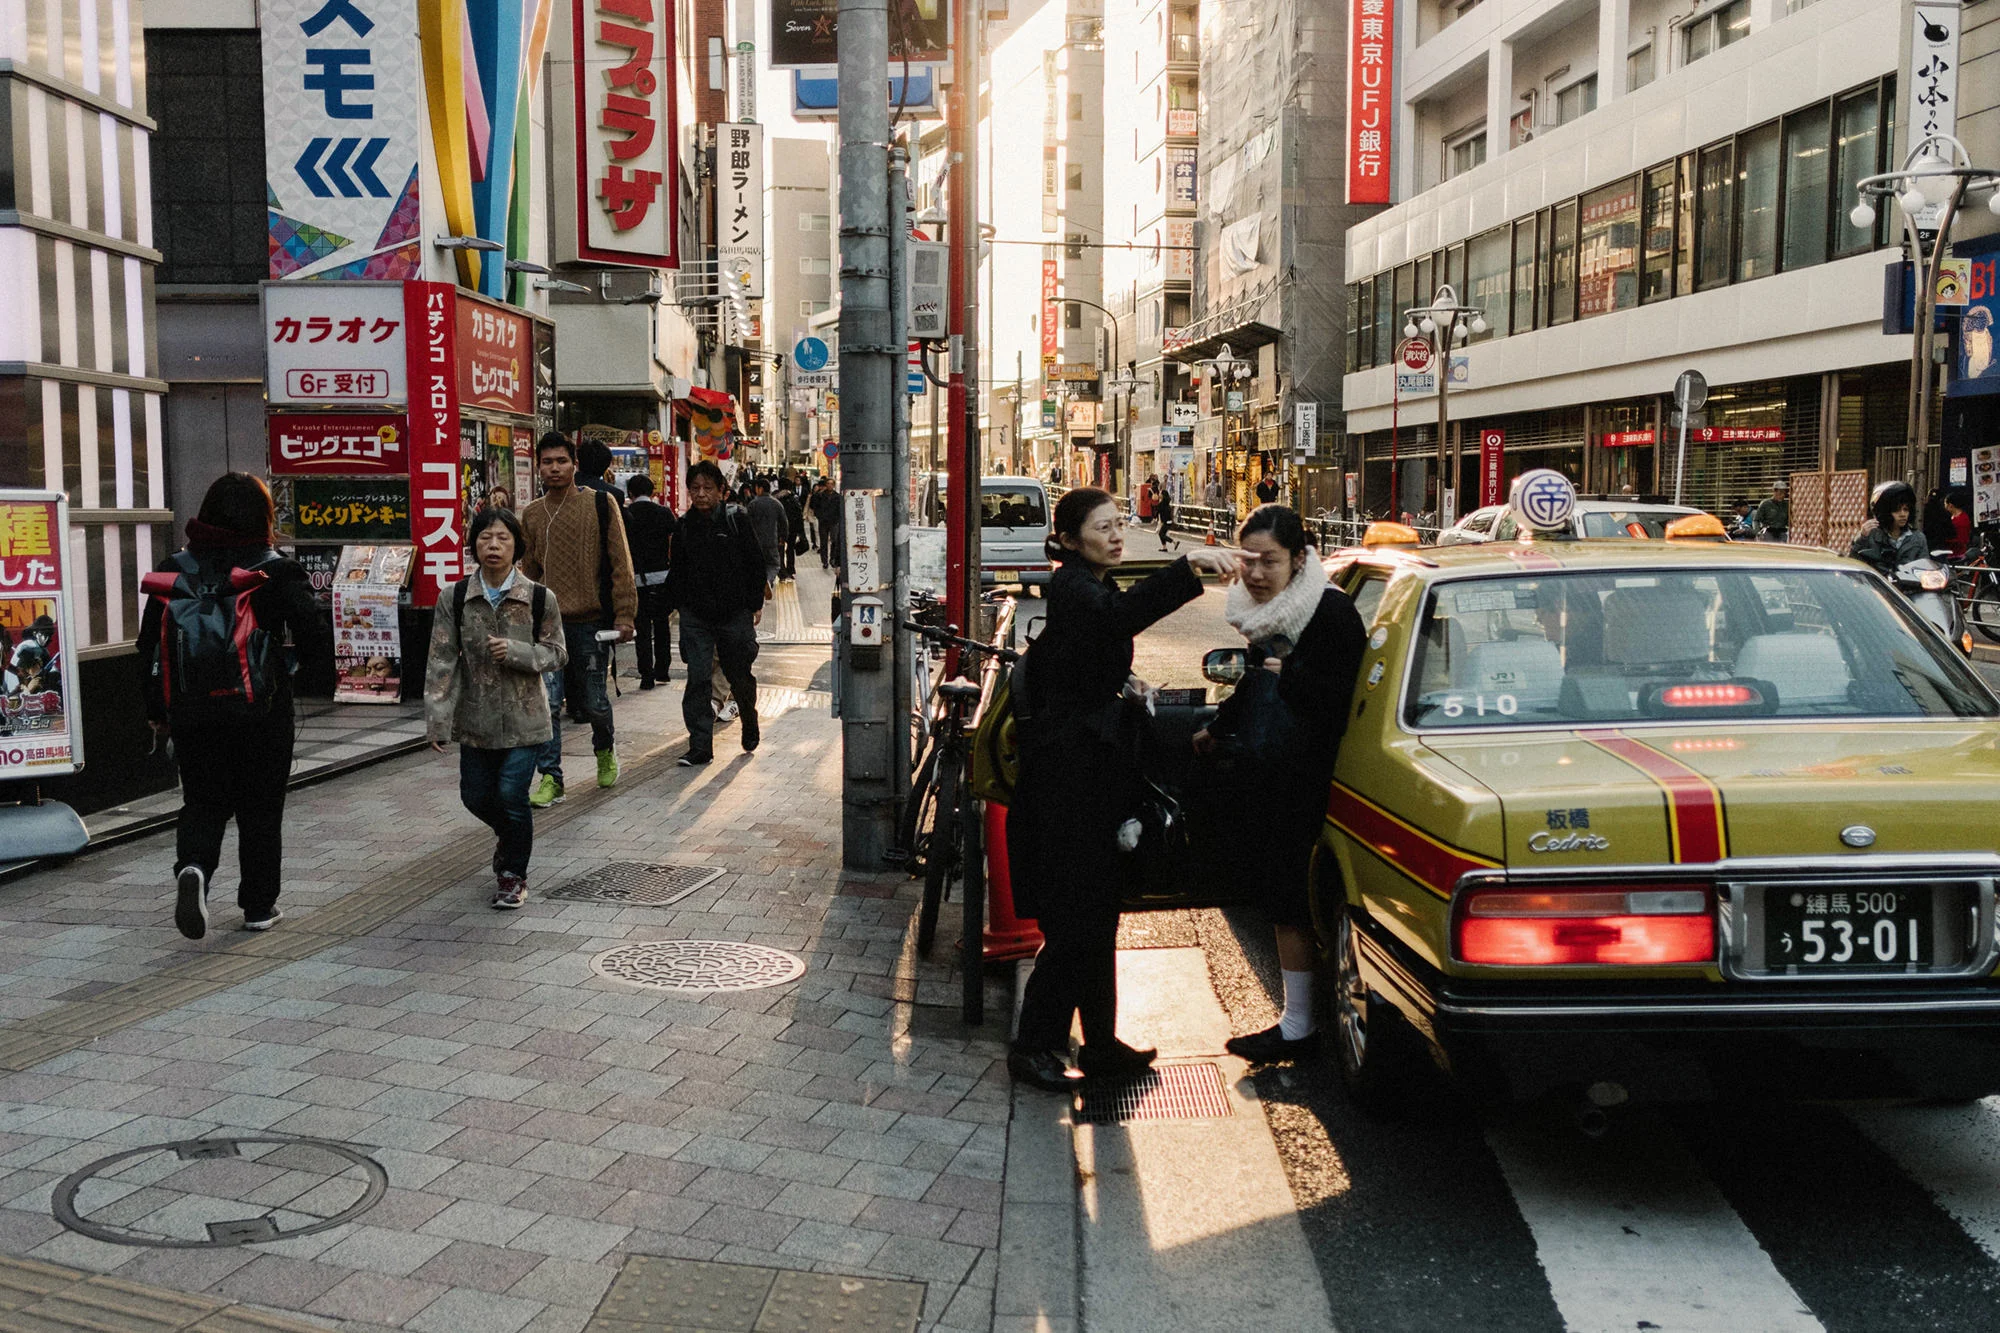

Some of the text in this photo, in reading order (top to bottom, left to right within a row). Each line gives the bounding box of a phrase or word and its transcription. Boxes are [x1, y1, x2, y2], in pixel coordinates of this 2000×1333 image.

[785, 20, 811, 32] Seven
[730, 129, 750, 243] 野郎ラーメン
[1919, 231, 1930, 239] 2F
[1970, 260, 1996, 300] B1
[274, 316, 399, 343] カラオケ
[472, 309, 517, 349] カラオケ
[427, 293, 447, 446] パチンコ スロット
[472, 360, 520, 399] ビッグエコー
[797, 375, 828, 384] 歩行者優先
[300, 374, 376, 394] 6F 受付
[280, 434, 399, 459] ビッグエコー
[299, 502, 407, 526] びっくりドンキー
[422, 462, 462, 591] コスモ
[1444, 694, 1518, 718] 510
[1546, 808, 1590, 830] 板橋
[1528, 832, 1609, 854] Cedric
[1806, 892, 1897, 914] 練馬 500
[1802, 919, 1919, 963] 53-01
